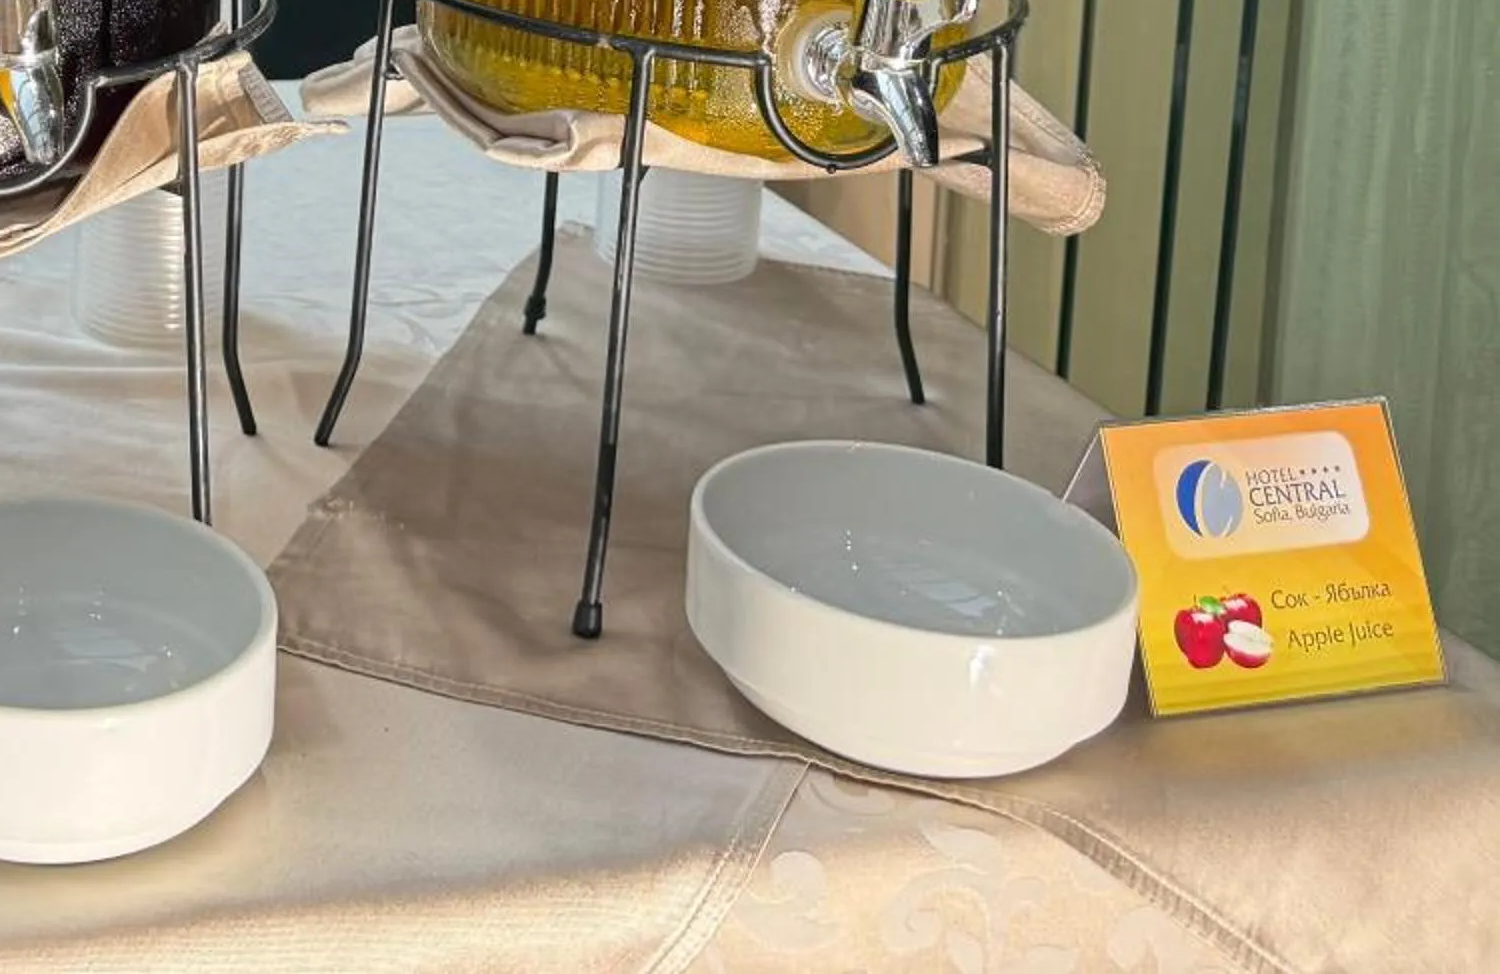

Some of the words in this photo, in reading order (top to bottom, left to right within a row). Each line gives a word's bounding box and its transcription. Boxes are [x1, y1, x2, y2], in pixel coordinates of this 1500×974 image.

[1245, 467, 1296, 486] HOTEL
[1249, 479, 1347, 507] CENTRAL
[1295, 502, 1351, 521] Bulgaria
[1270, 588, 1309, 610] Сок
[1325, 582, 1392, 604] Ябълка
[1287, 626, 1345, 653] Apple
[1348, 620, 1394, 648] Juice
